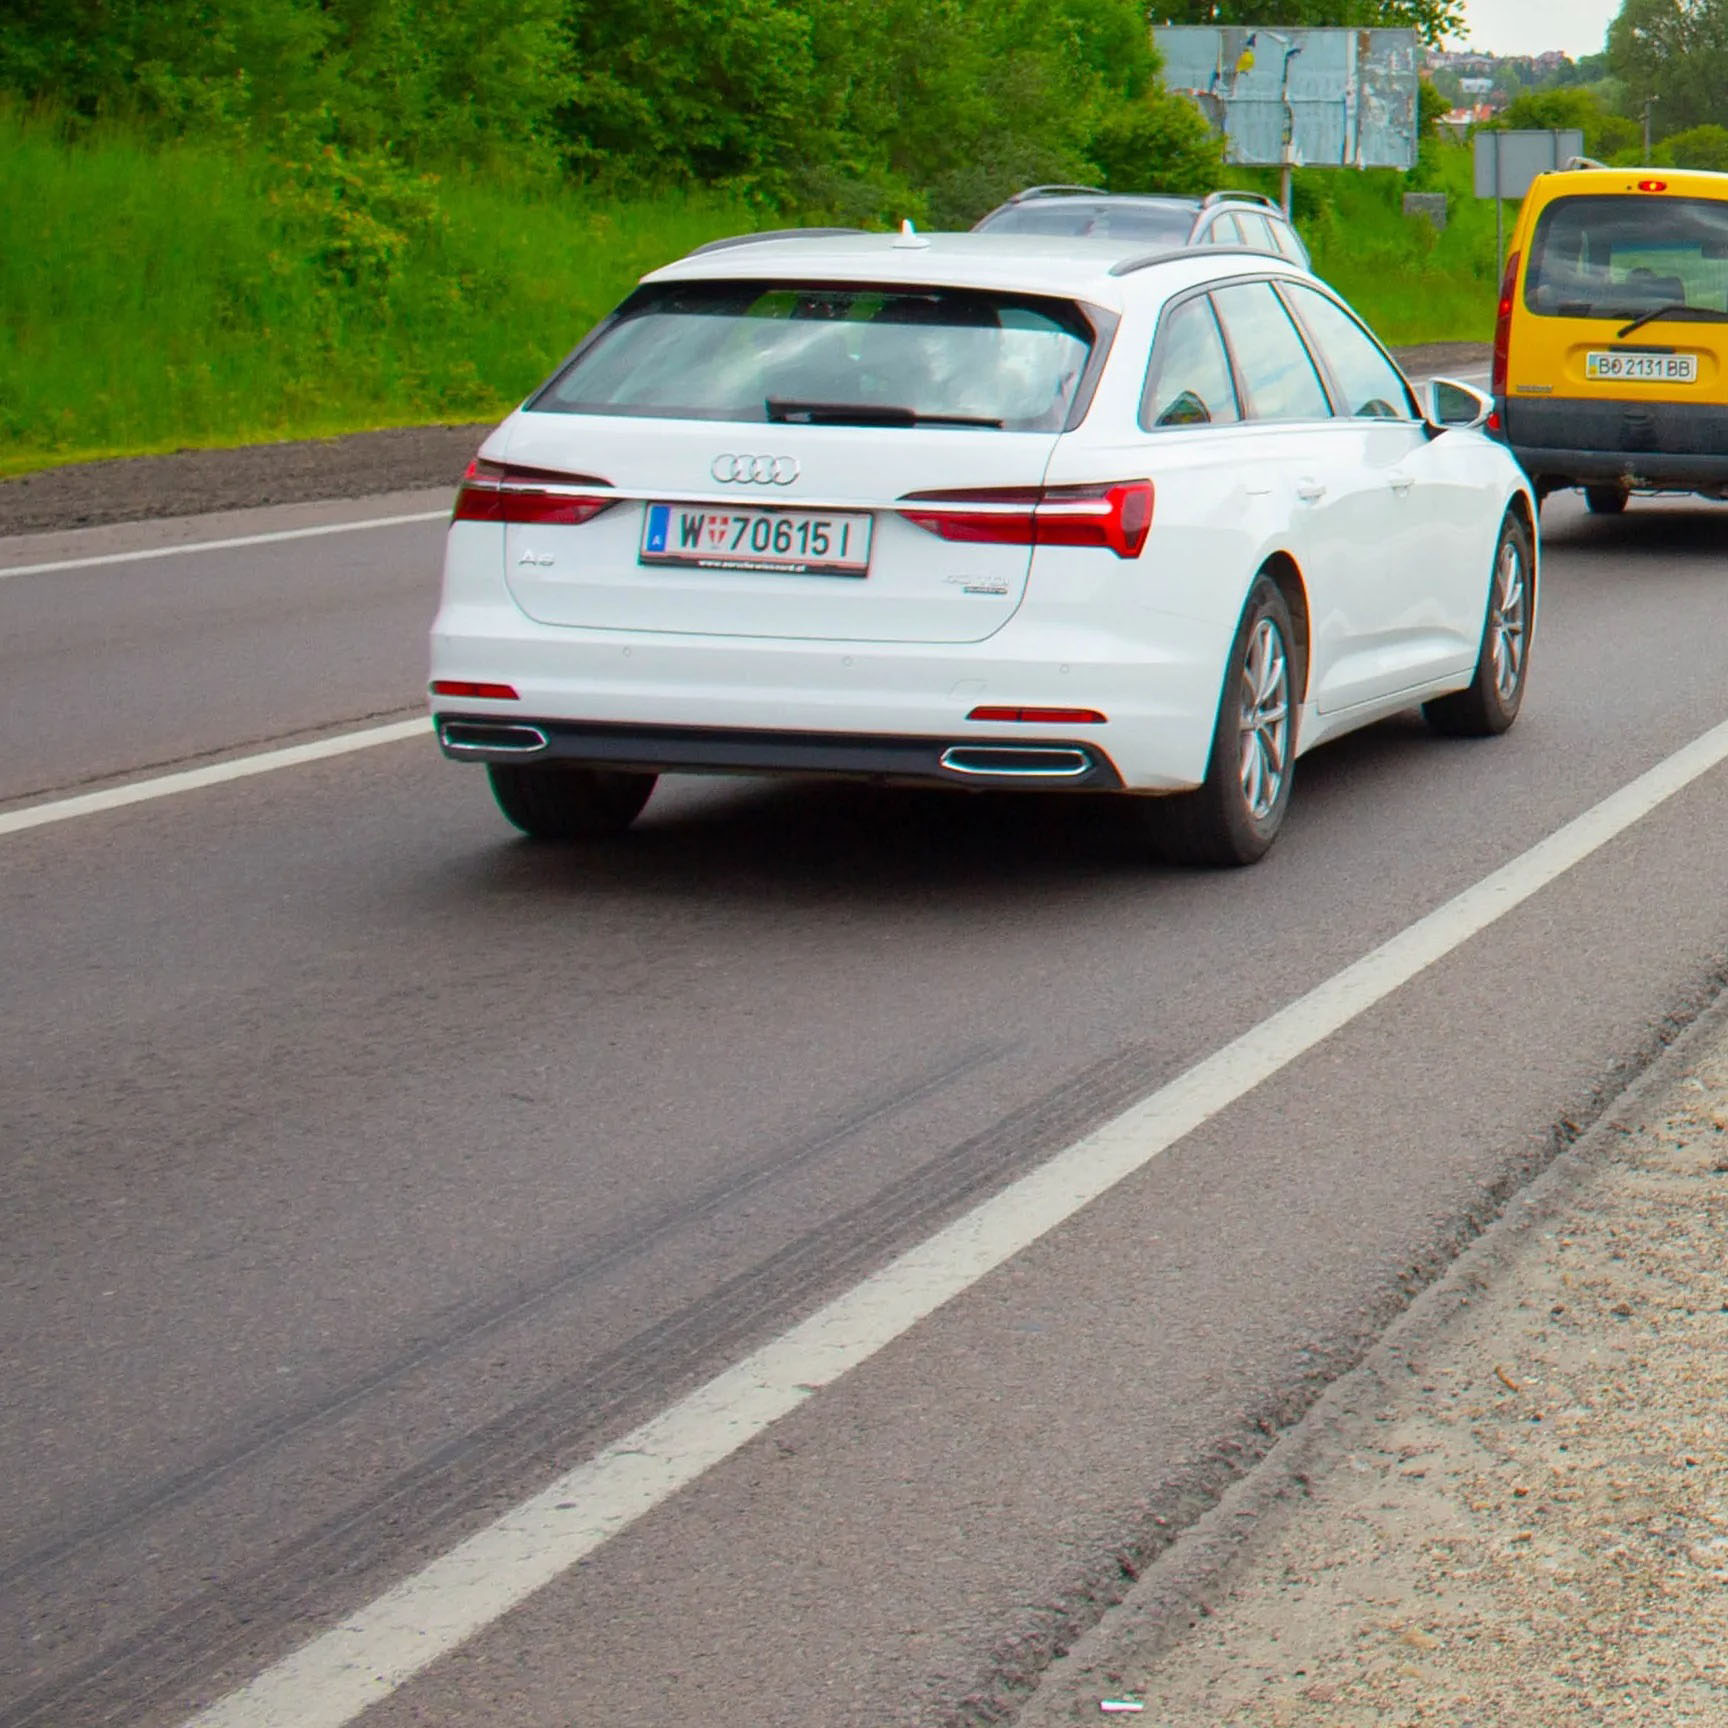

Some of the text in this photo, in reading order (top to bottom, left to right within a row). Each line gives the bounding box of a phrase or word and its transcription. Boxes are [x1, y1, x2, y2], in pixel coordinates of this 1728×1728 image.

[1626, 359, 1663, 377] 2131
[1667, 360, 1690, 378] BB
[681, 513, 704, 548] W
[730, 517, 831, 556] 70615
